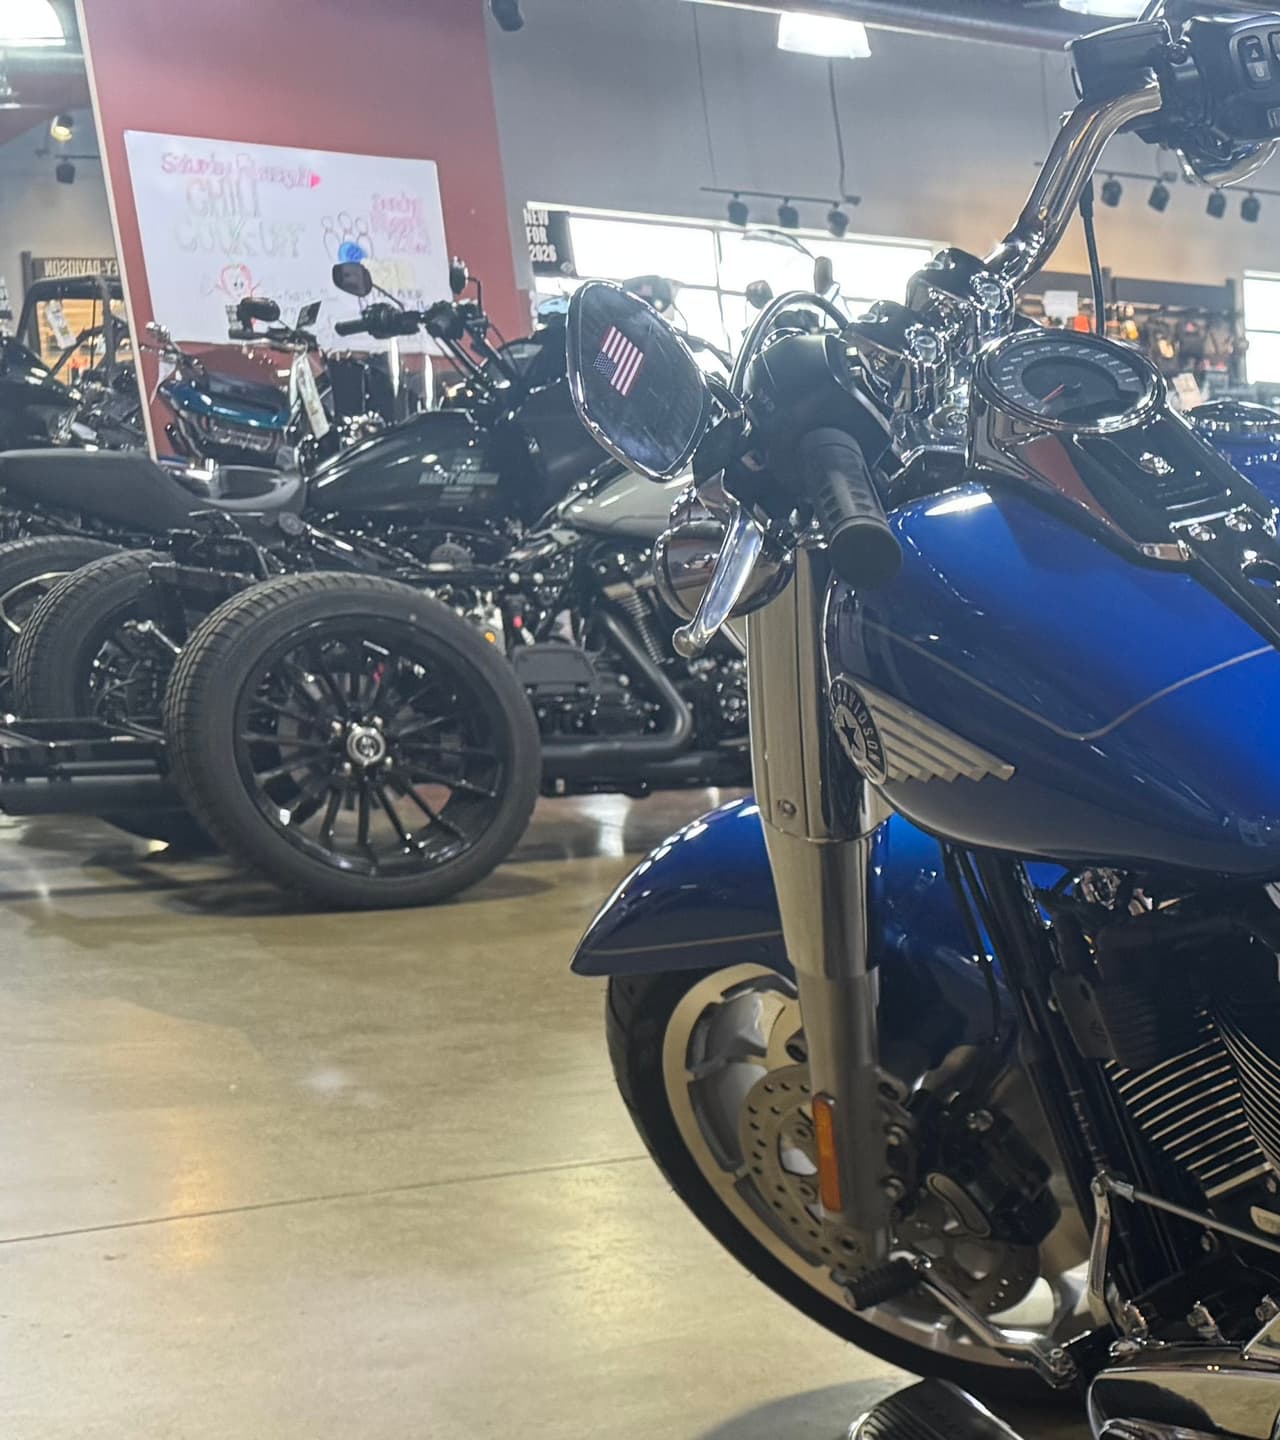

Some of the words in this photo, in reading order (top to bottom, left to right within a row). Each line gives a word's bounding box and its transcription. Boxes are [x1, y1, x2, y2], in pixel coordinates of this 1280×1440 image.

[523, 208, 548, 225] NEW
[526, 226, 548, 244] FOR
[528, 244, 557, 262] 2026
